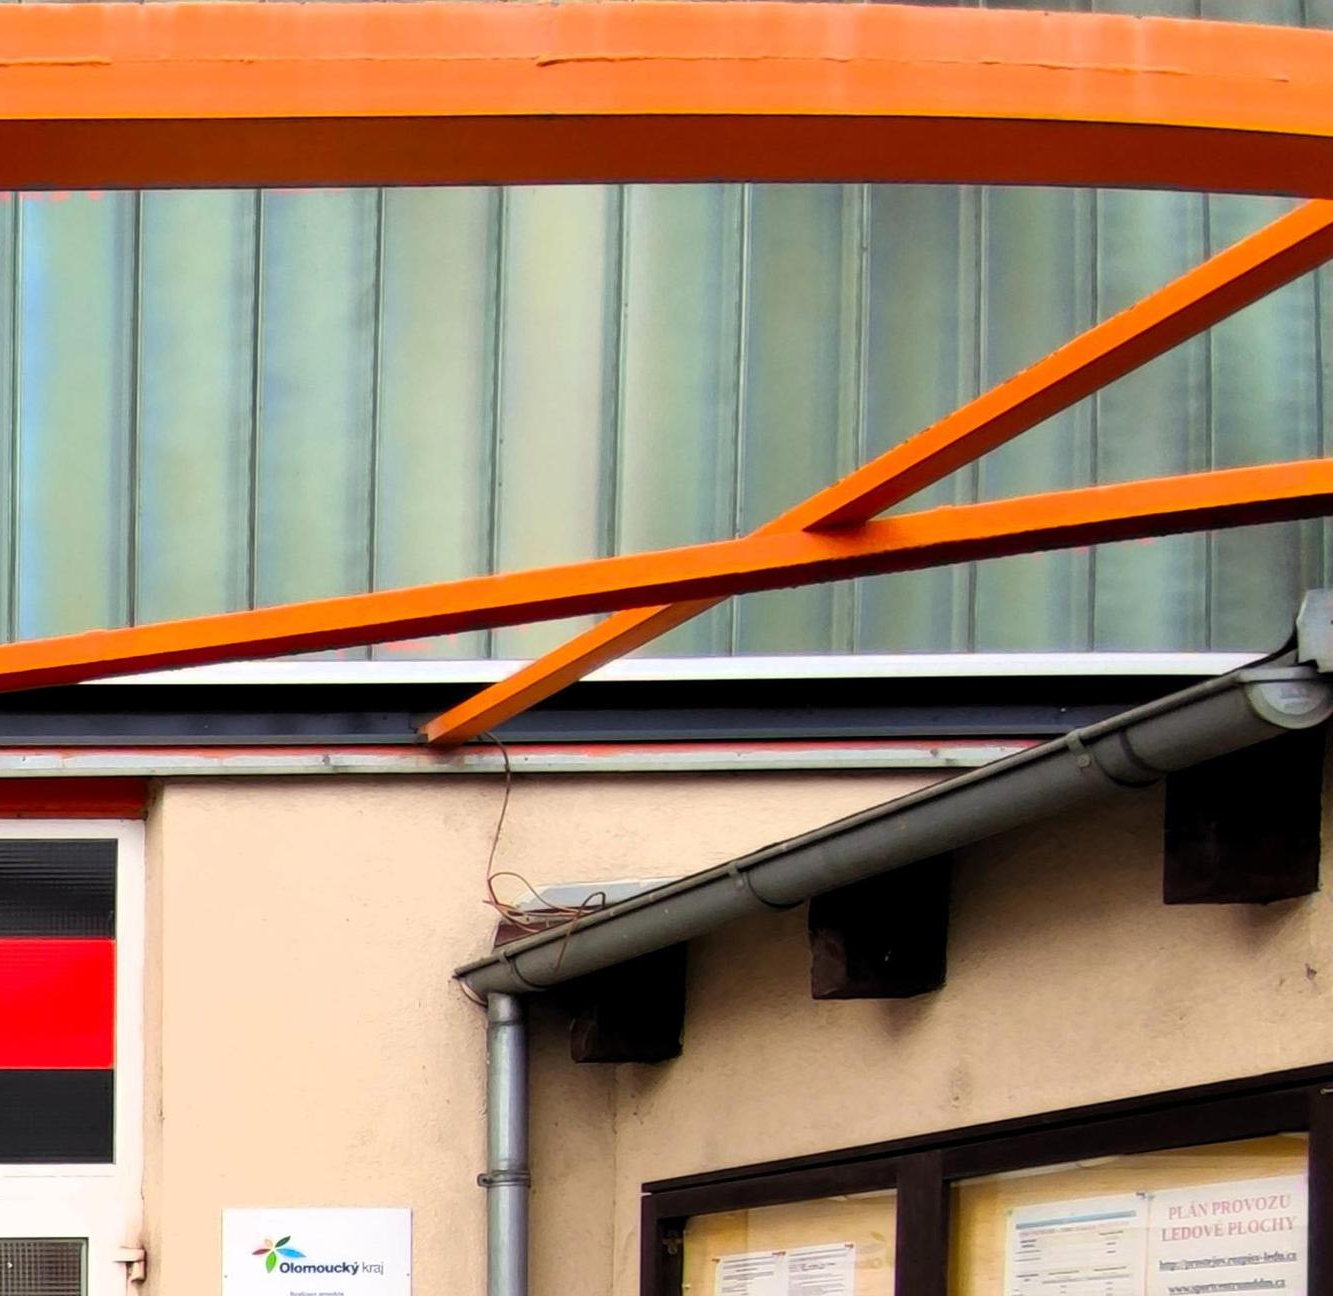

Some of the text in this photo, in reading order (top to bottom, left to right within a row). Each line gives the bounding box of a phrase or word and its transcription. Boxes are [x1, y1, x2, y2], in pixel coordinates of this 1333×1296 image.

[1168, 1195, 1292, 1220] PLÁN PROVOZU
[1162, 1216, 1297, 1242] LEDOVÉ PLOCHY
[279, 1261, 384, 1276] Olomoucký kraj
